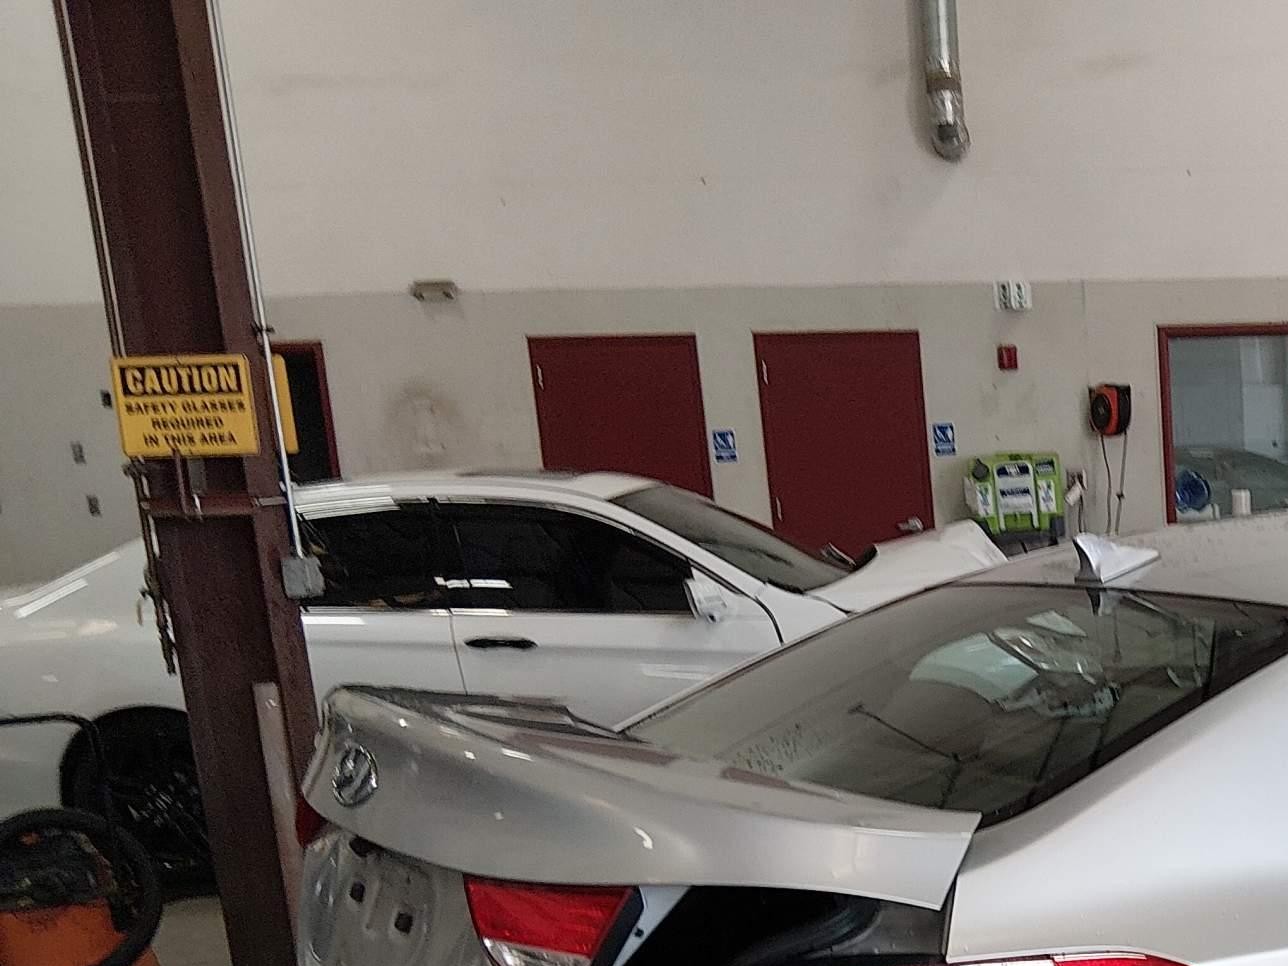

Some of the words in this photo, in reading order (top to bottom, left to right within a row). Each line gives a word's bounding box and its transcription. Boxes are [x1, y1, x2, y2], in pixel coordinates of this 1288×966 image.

[124, 365, 239, 395] CAUTION
[151, 416, 224, 430] REQUIRED
[144, 433, 159, 446] IN
[201, 431, 237, 445] AREA
